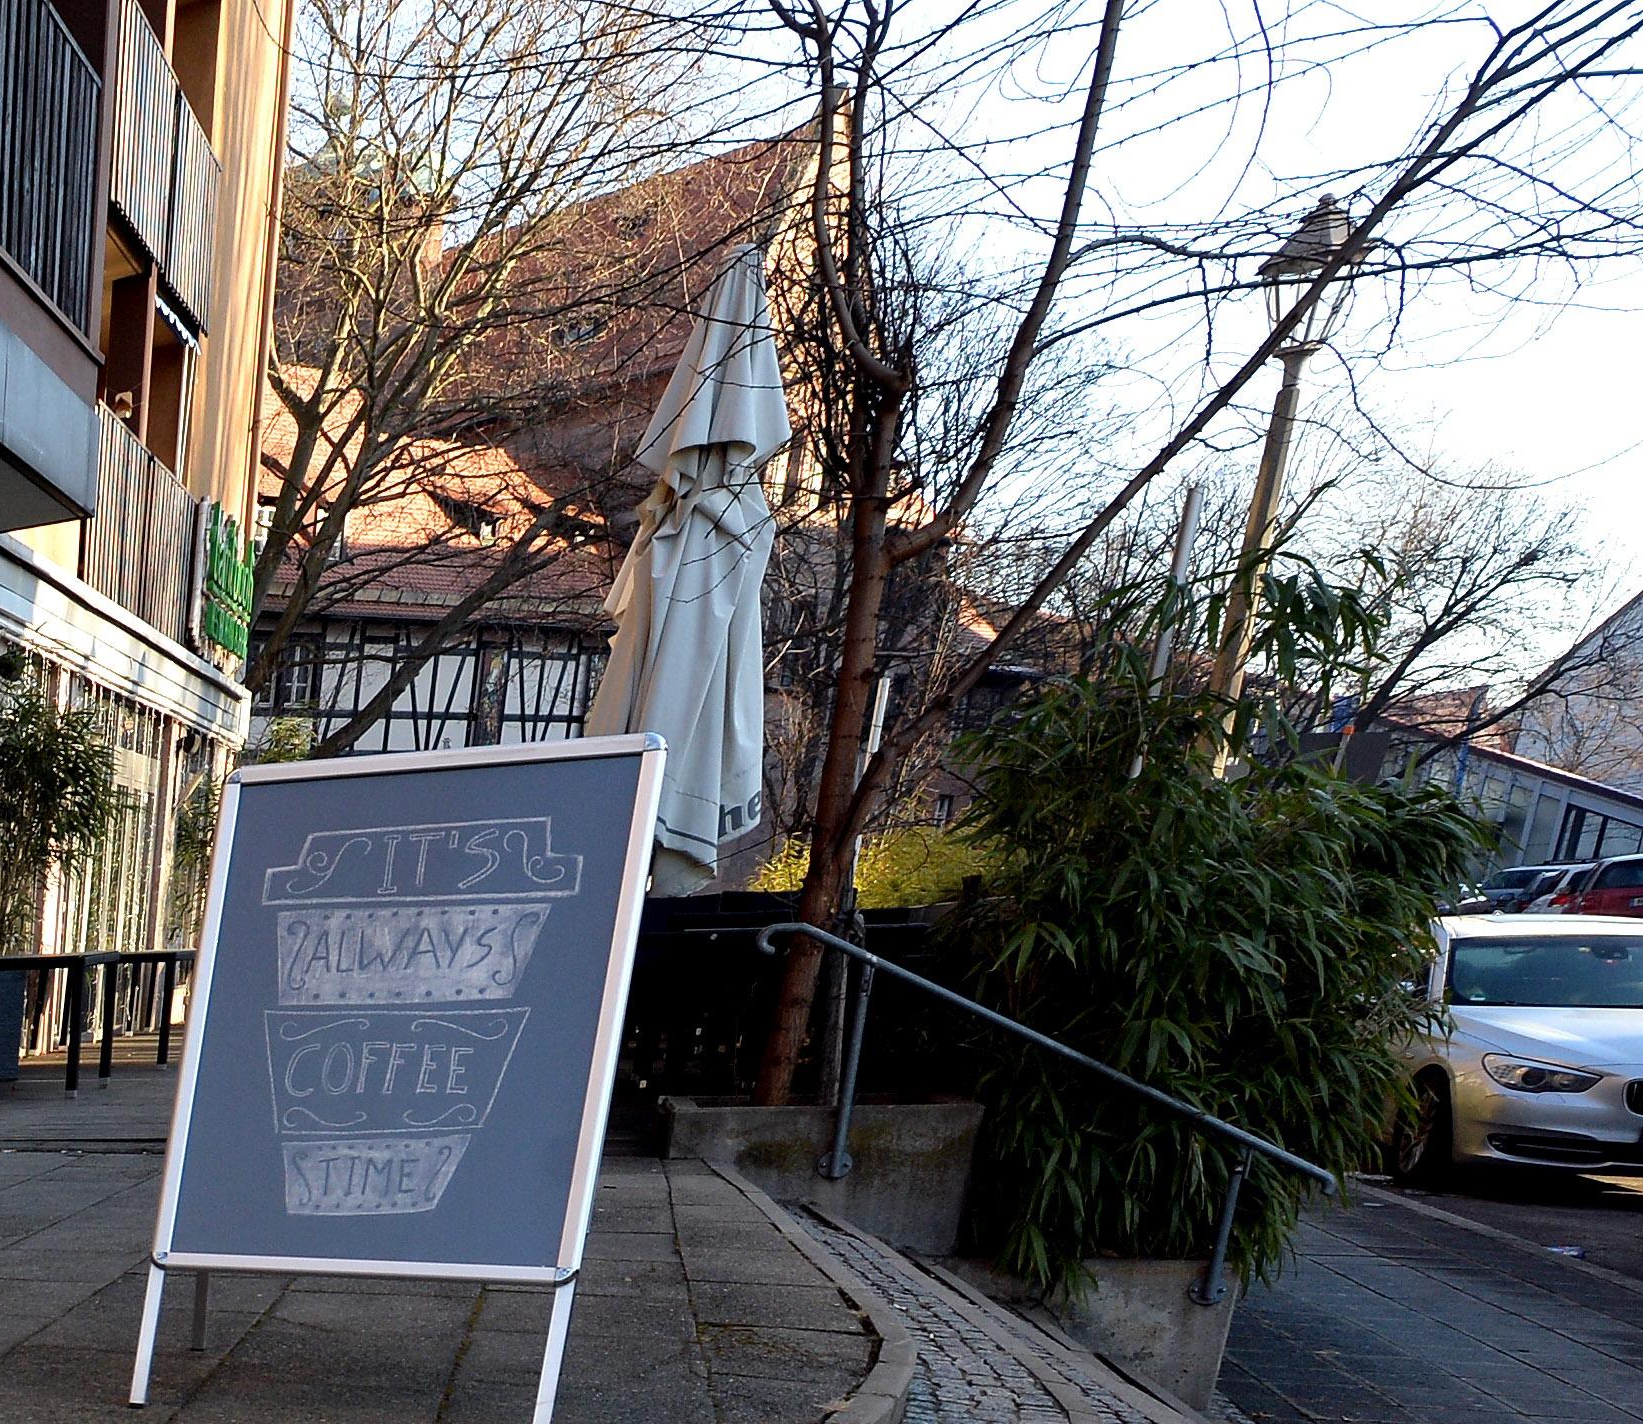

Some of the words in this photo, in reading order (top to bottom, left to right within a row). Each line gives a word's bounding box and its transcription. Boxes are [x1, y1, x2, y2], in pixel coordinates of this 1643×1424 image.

[377, 829, 501, 894] IT'S
[304, 926, 495, 976] ALWAYS
[284, 1041, 476, 1098] COFFEE
[319, 1156, 421, 1199] TIME
